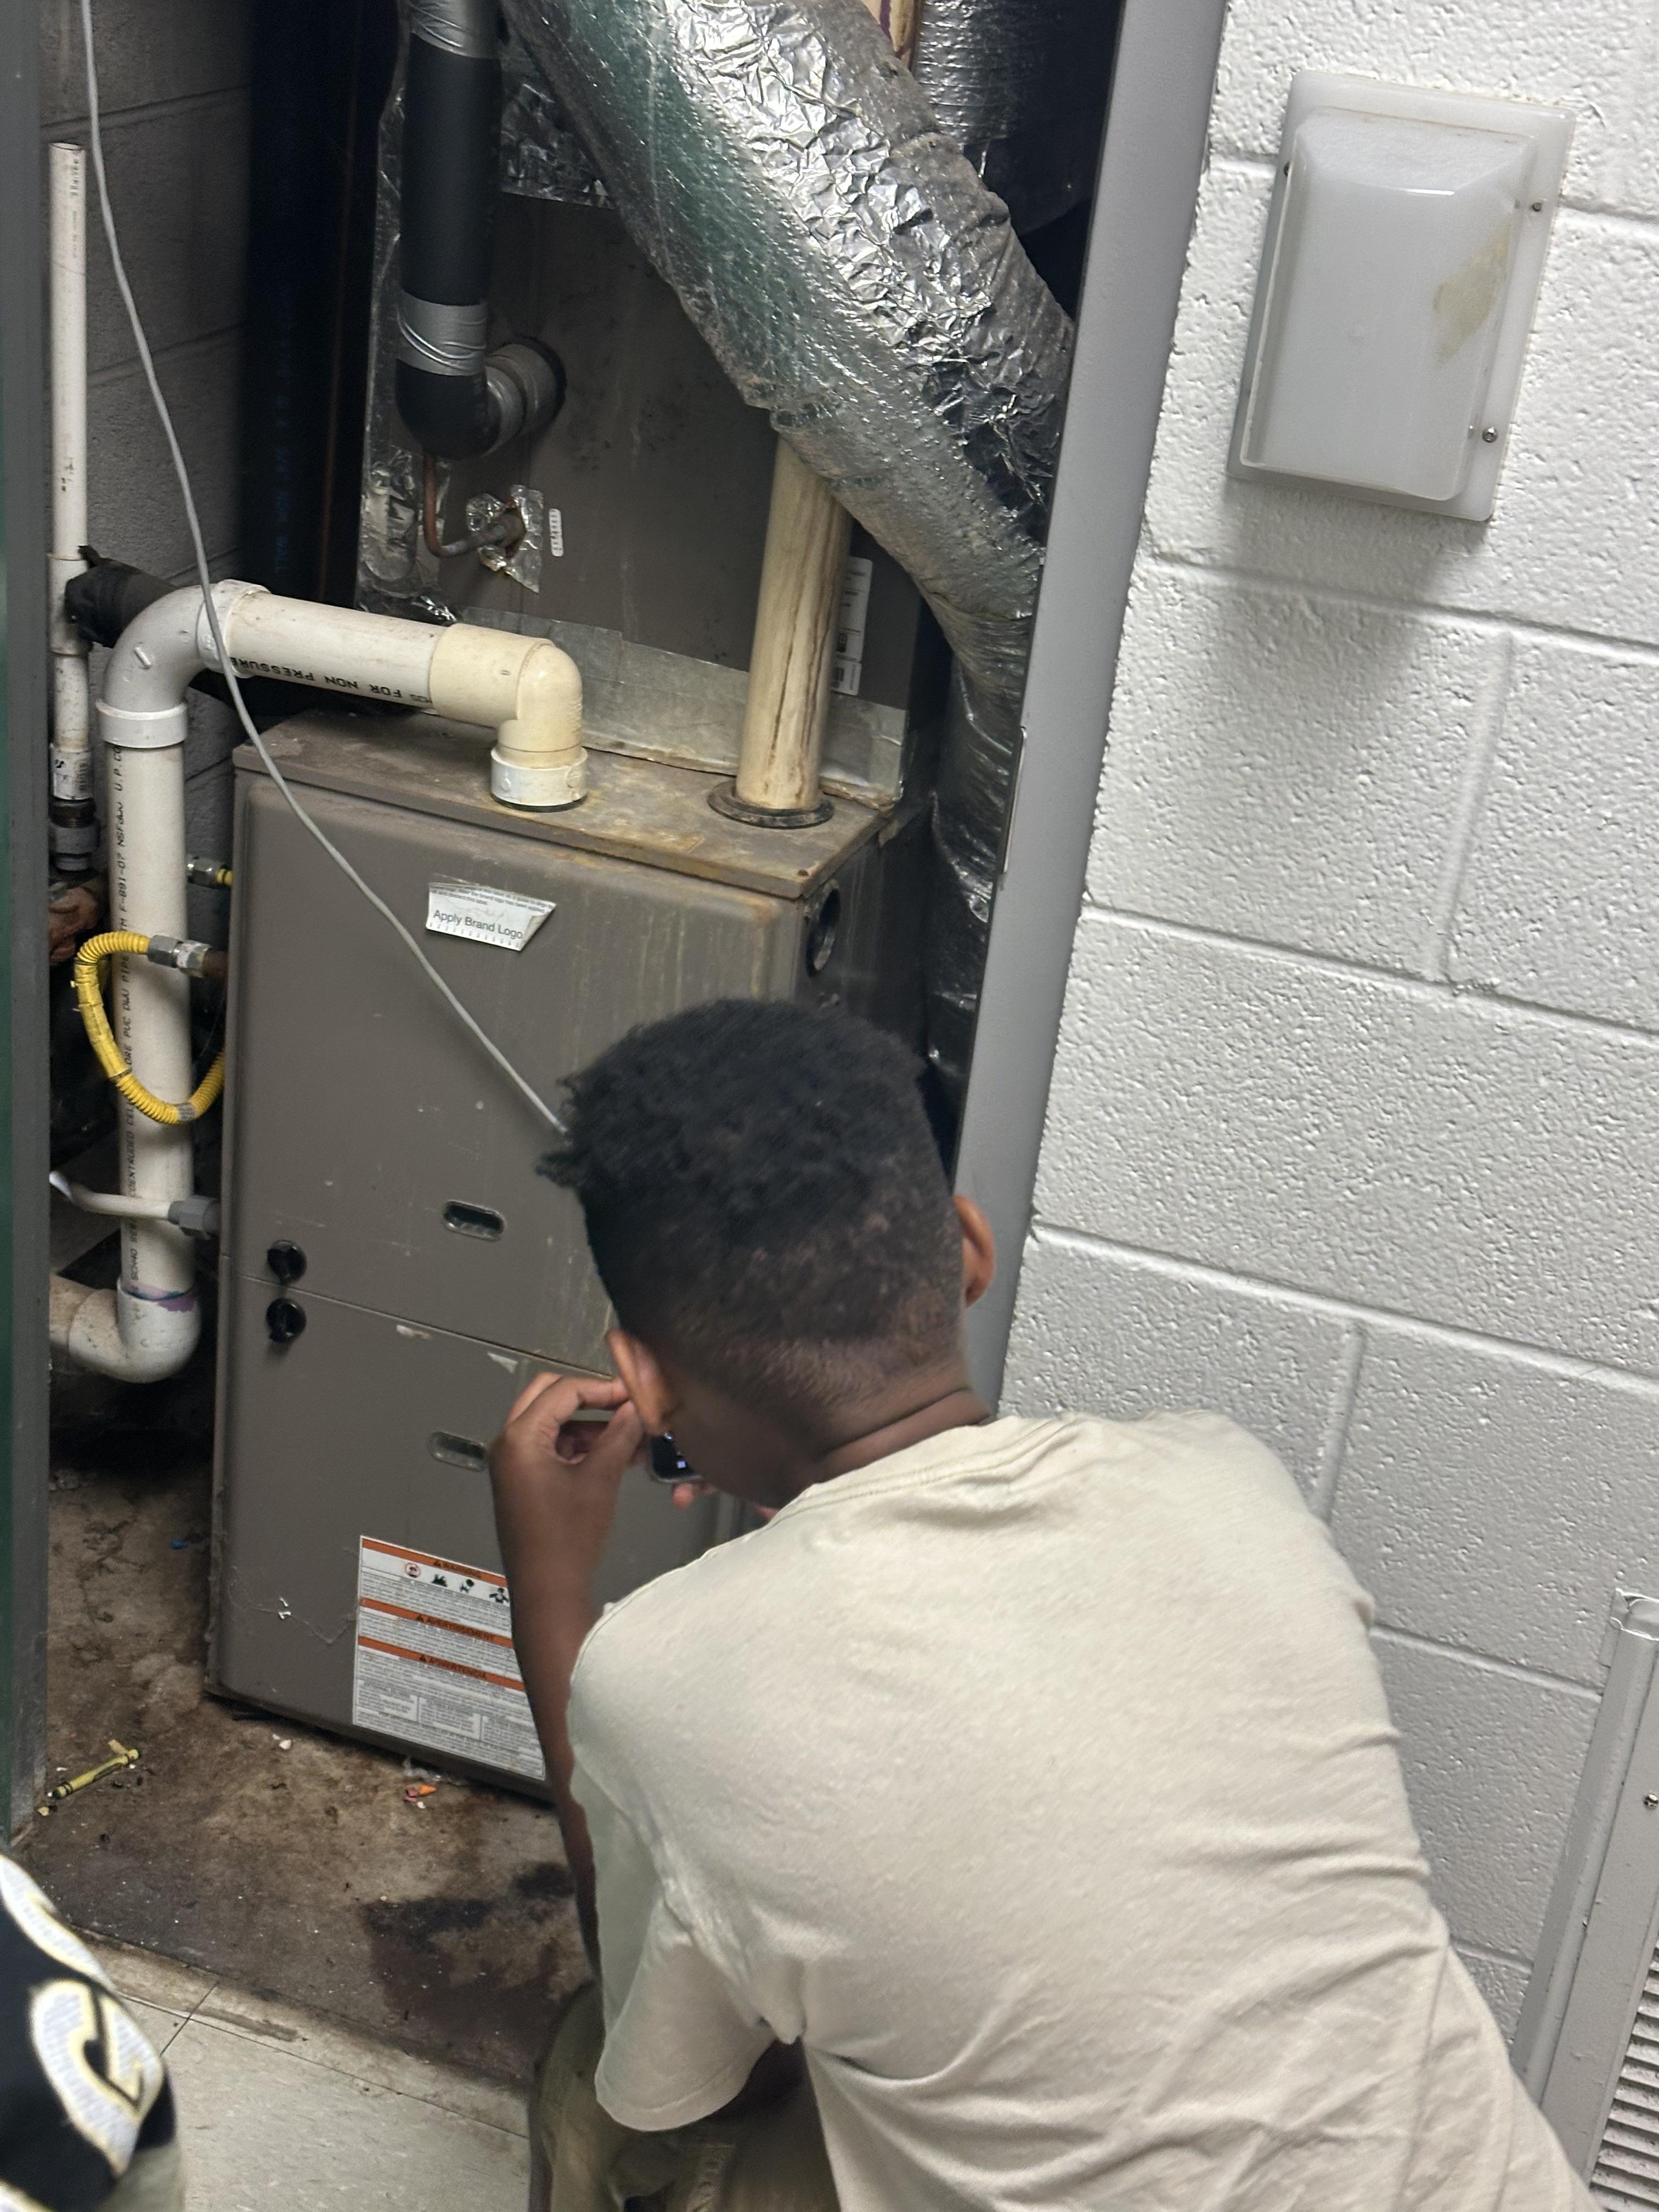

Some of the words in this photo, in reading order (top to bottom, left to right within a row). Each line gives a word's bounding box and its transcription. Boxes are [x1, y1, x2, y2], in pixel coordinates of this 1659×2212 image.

[230, 657, 314, 681] PRESSURE
[323, 675, 358, 690] NON
[369, 685, 402, 698] FOR
[433, 909, 462, 926] Apply
[465, 917, 495, 932] Brand
[498, 924, 523, 940] Logo
